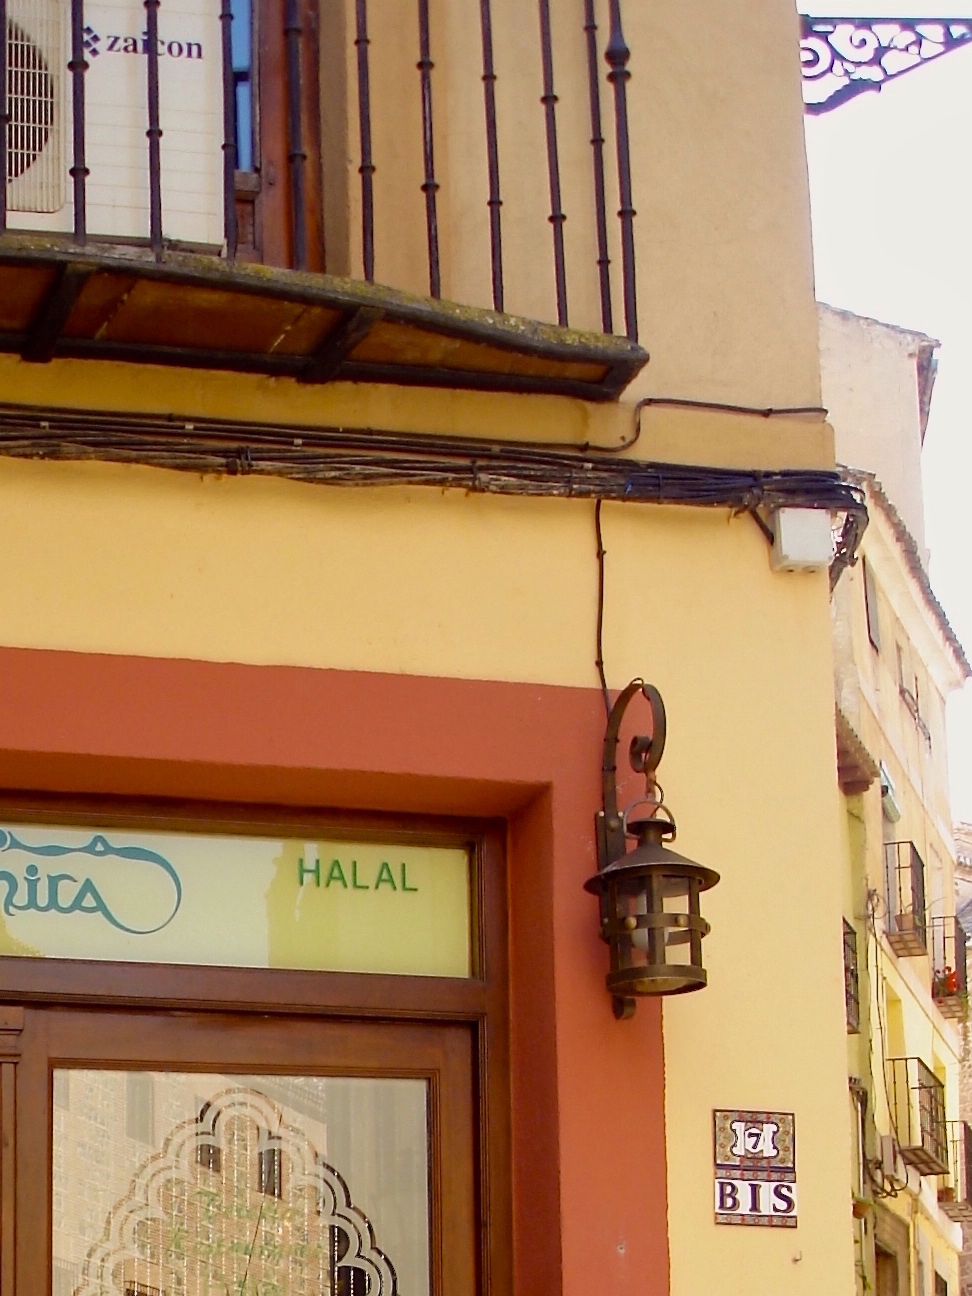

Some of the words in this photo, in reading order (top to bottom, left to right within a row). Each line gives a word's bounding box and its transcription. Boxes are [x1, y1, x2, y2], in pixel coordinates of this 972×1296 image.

[106, 30, 204, 60] zaicon
[298, 857, 418, 893] HALAL
[747, 1131, 762, 1150] 7
[717, 1180, 795, 1213] BIS
